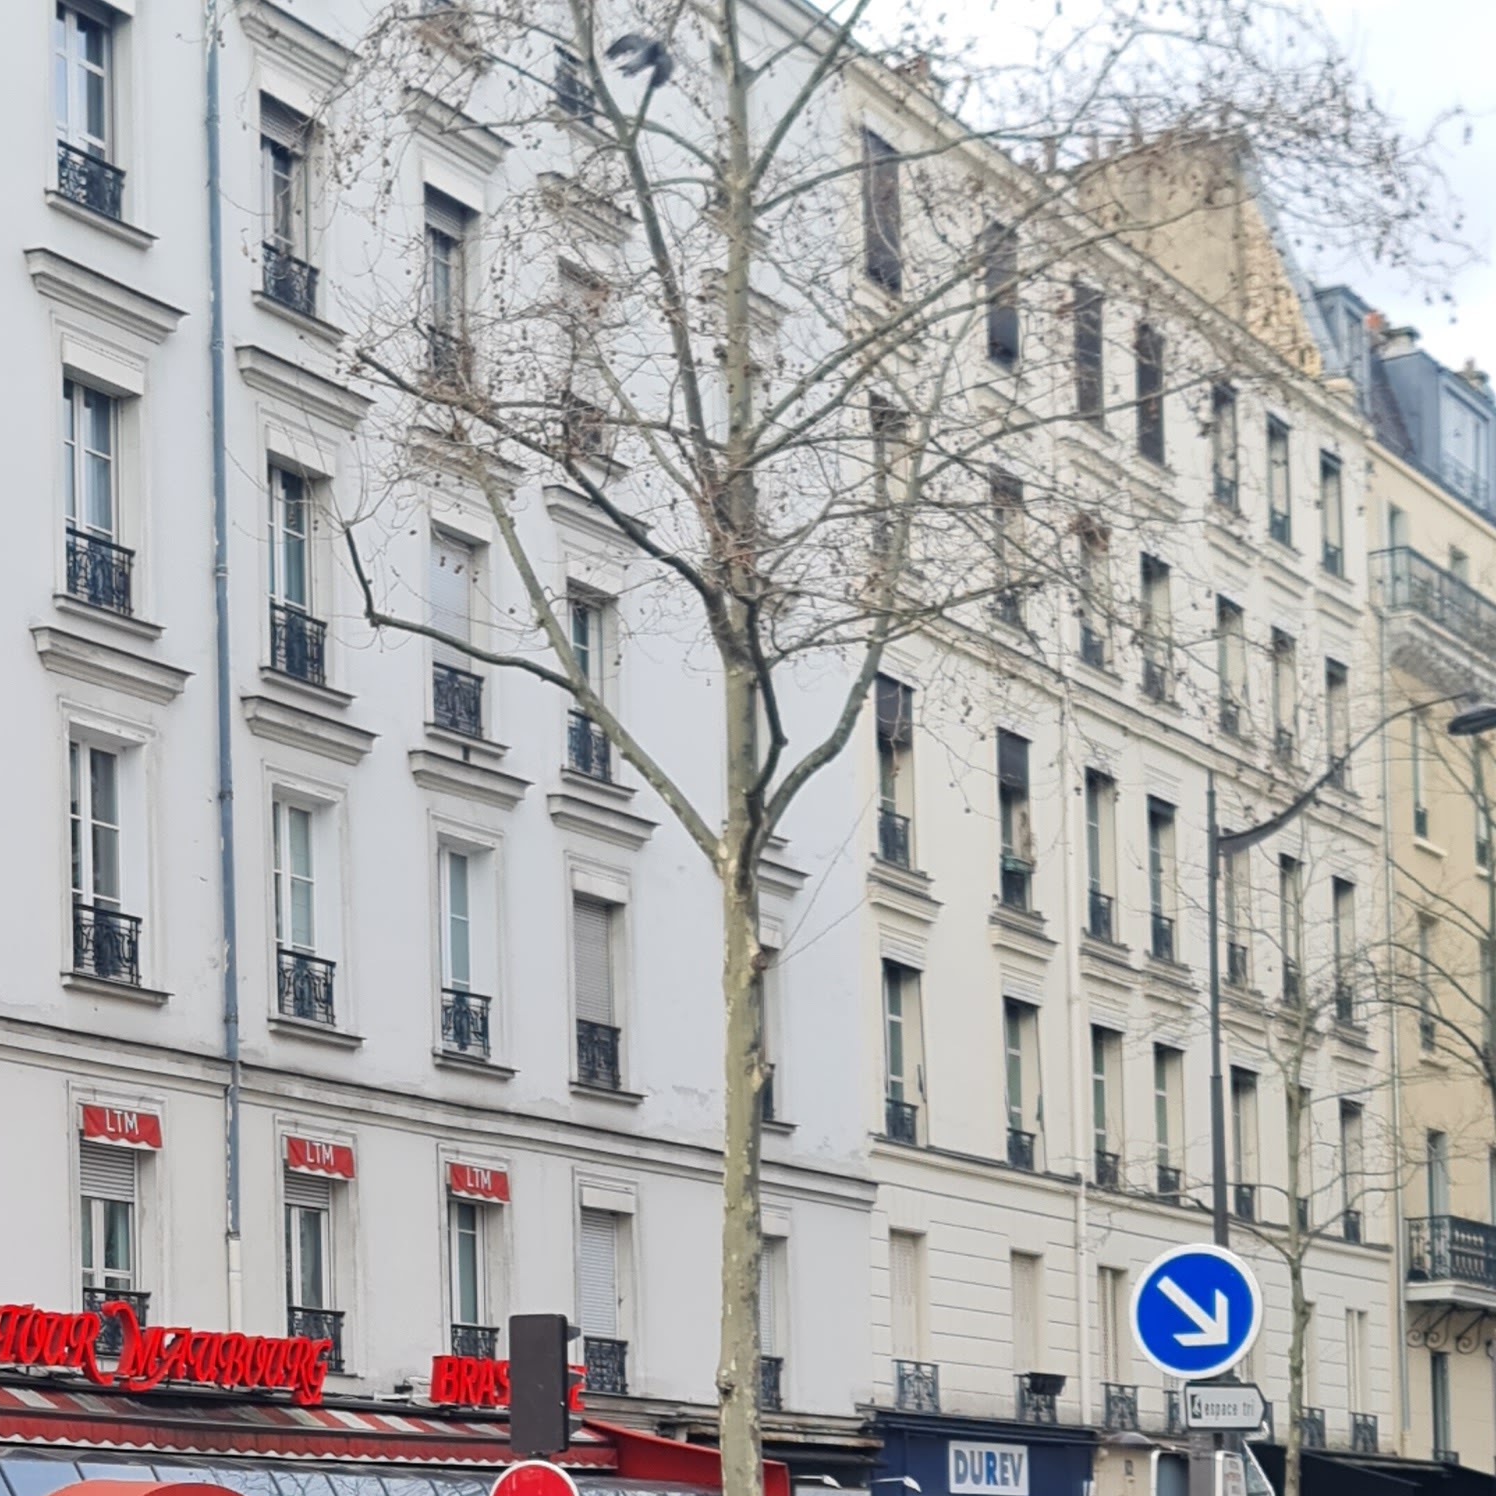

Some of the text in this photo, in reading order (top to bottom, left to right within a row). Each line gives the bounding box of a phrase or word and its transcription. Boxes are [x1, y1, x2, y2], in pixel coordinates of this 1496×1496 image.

[105, 1109, 138, 1135] LTM
[306, 1141, 335, 1166] LTM
[467, 1167, 492, 1191] LTM
[954, 1449, 1024, 1488] DUREV
